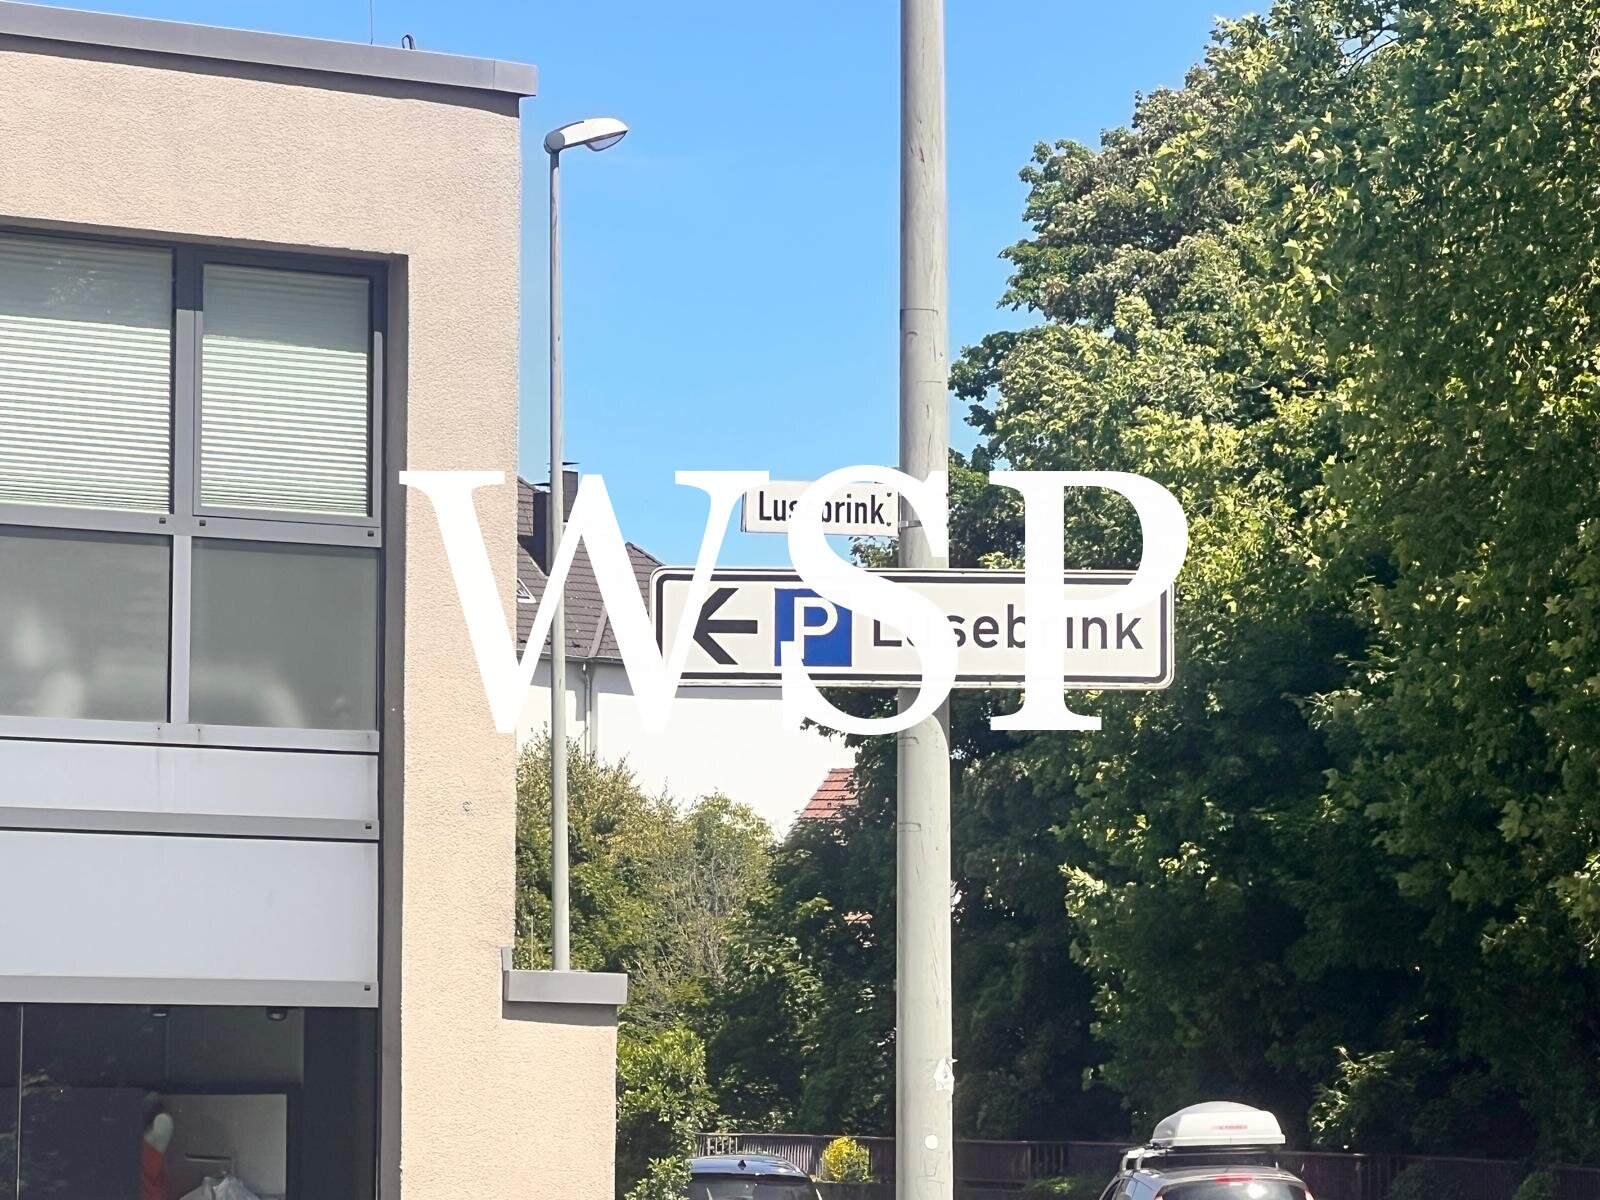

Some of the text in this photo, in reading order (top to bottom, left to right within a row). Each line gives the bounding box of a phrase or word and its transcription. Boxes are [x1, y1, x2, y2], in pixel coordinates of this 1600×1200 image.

[759, 490, 885, 525] Lusbrink
[793, 596, 1144, 661] P Lsebink
